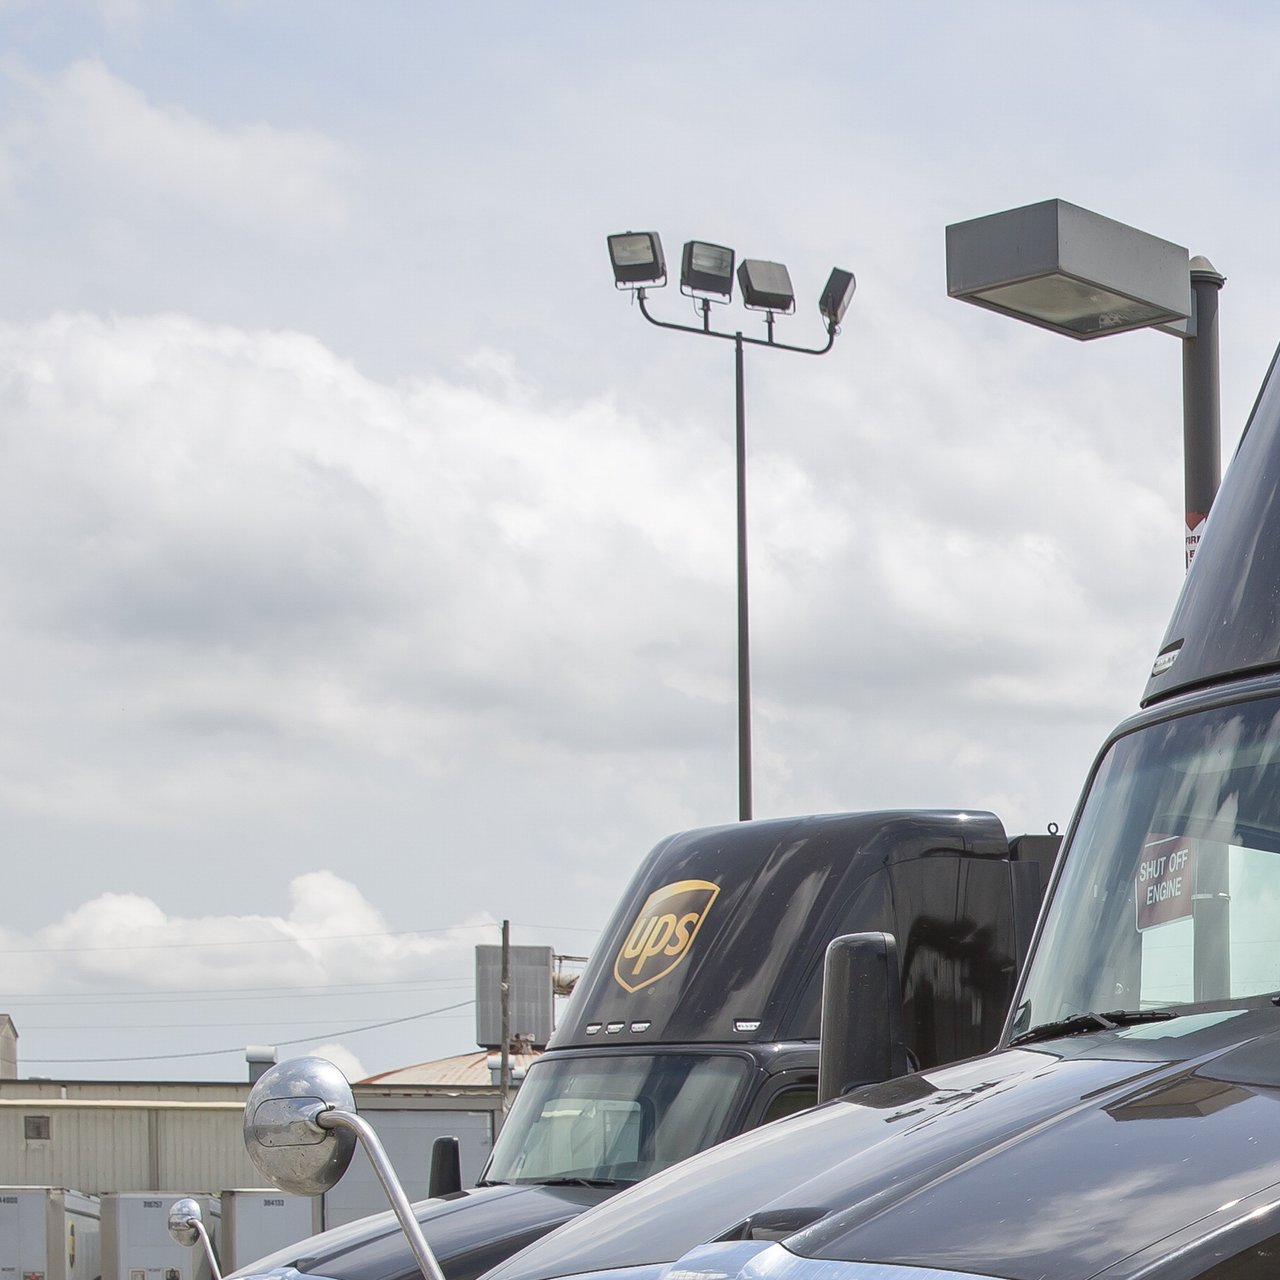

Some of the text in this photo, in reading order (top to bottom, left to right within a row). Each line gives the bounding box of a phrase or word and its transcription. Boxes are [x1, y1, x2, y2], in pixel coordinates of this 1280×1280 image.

[1139, 848, 1189, 882] SHUT OFF
[1146, 876, 1183, 906] ENGINE
[624, 912, 700, 976] ups
